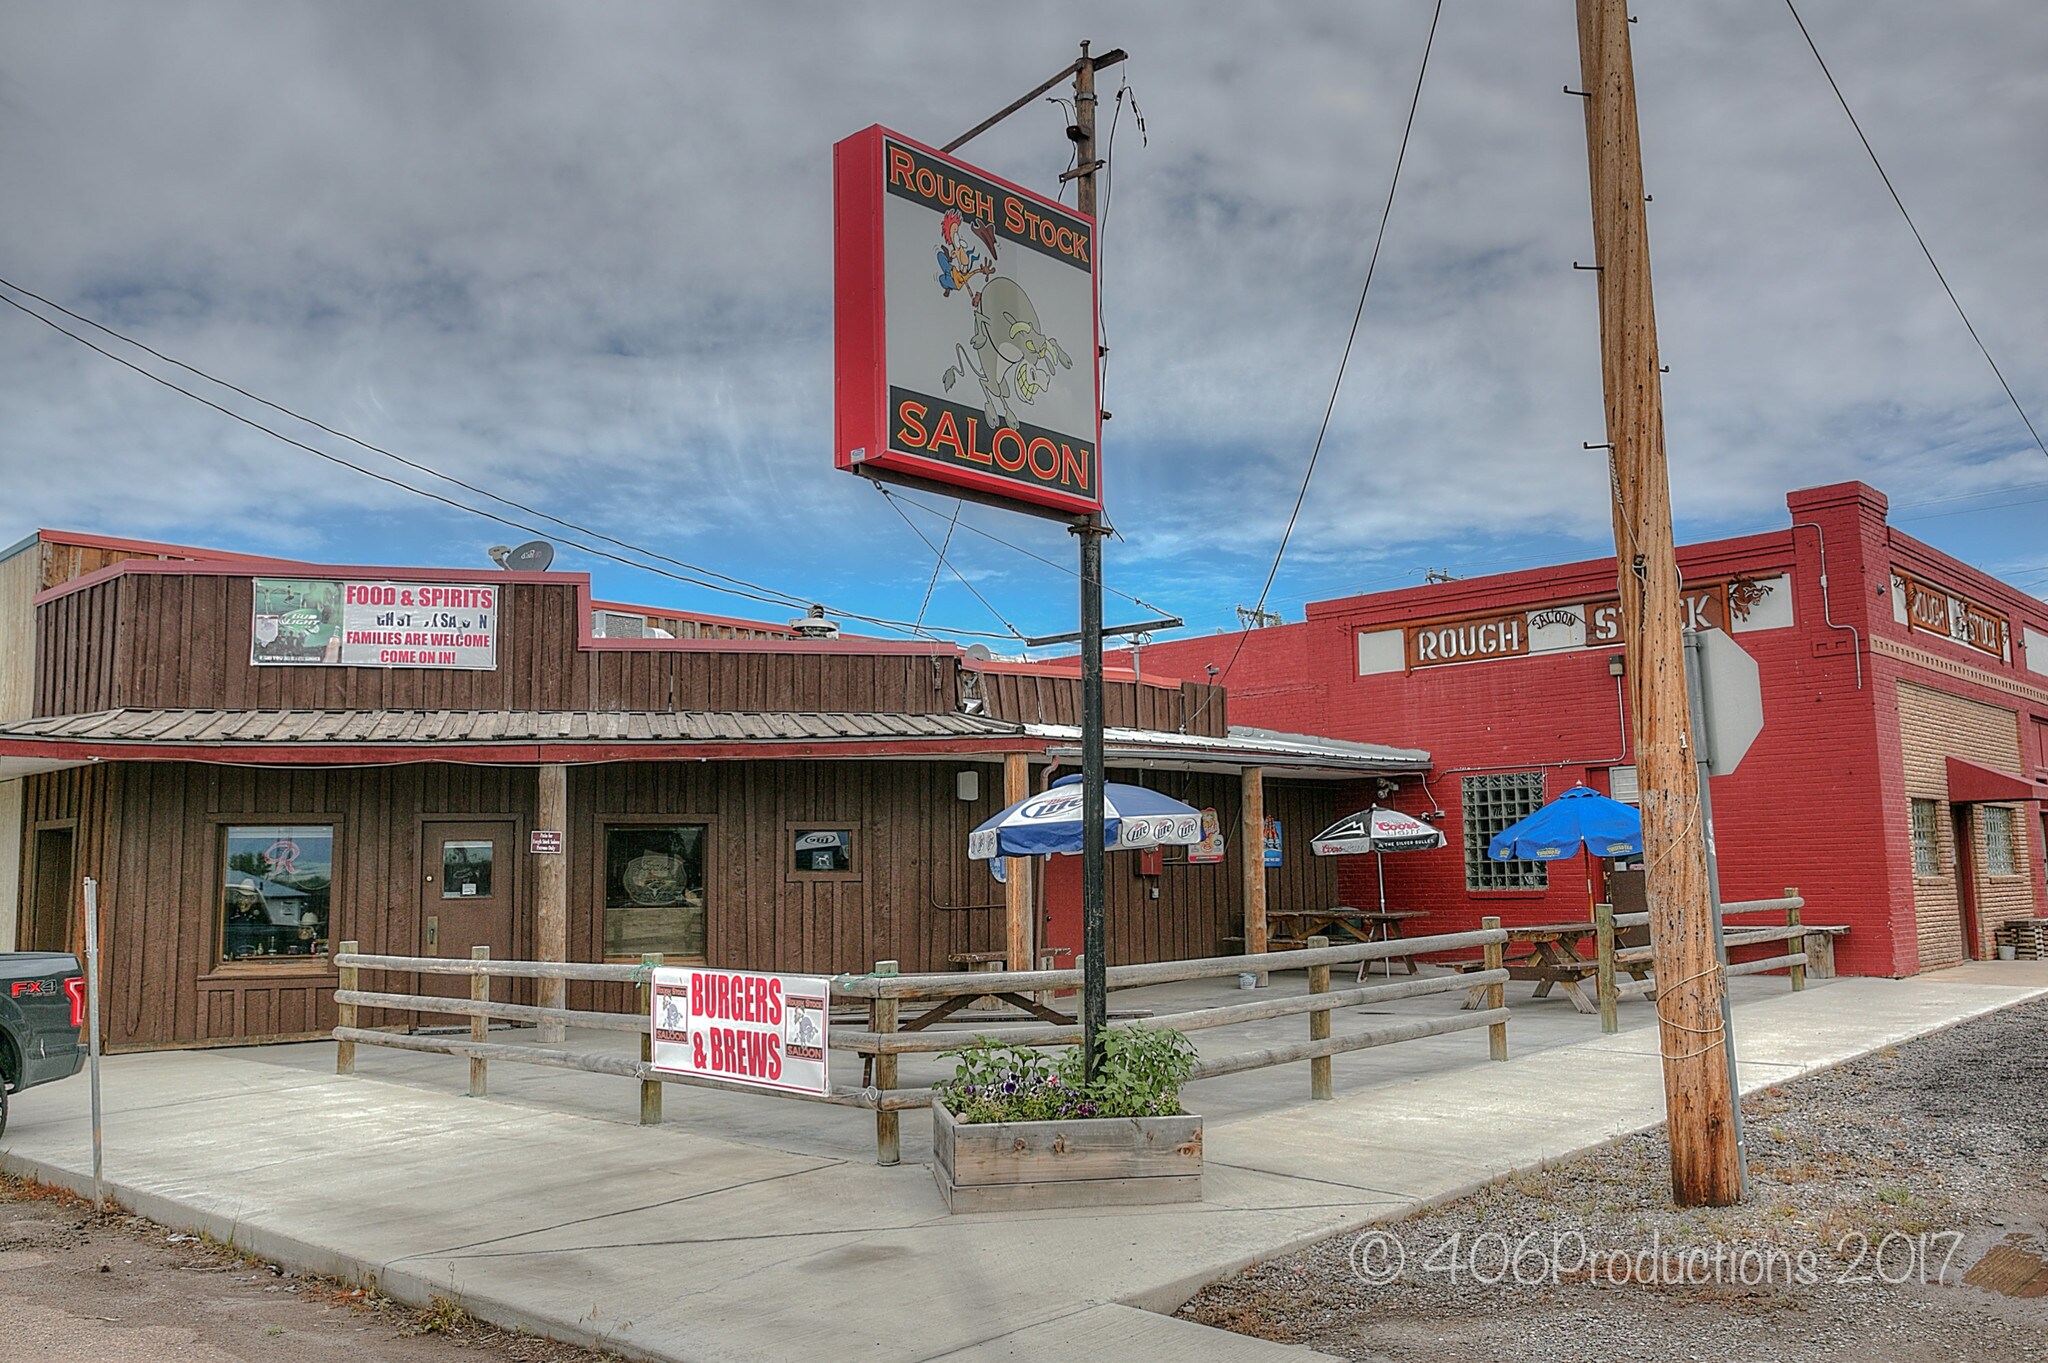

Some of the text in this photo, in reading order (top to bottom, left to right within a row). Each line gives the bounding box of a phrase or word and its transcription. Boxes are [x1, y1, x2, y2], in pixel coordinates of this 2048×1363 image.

[889, 145, 1090, 263] ROUGH STOCK
[897, 399, 1090, 491] SALOON
[346, 585, 493, 609] FOOD & SPIRITS
[346, 631, 490, 648] FAMILIES ARE WELCOME
[1418, 620, 1520, 661] ROUGH
[381, 650, 456, 664] COME ON IN!
[1376, 821, 1420, 831] Coors
[11, 979, 57, 999] FX4
[691, 973, 782, 1026] BURGERS
[656, 1030, 687, 1042] SALOON
[693, 1026, 782, 1081] & BREWS
[786, 1045, 822, 1059] SALOON
